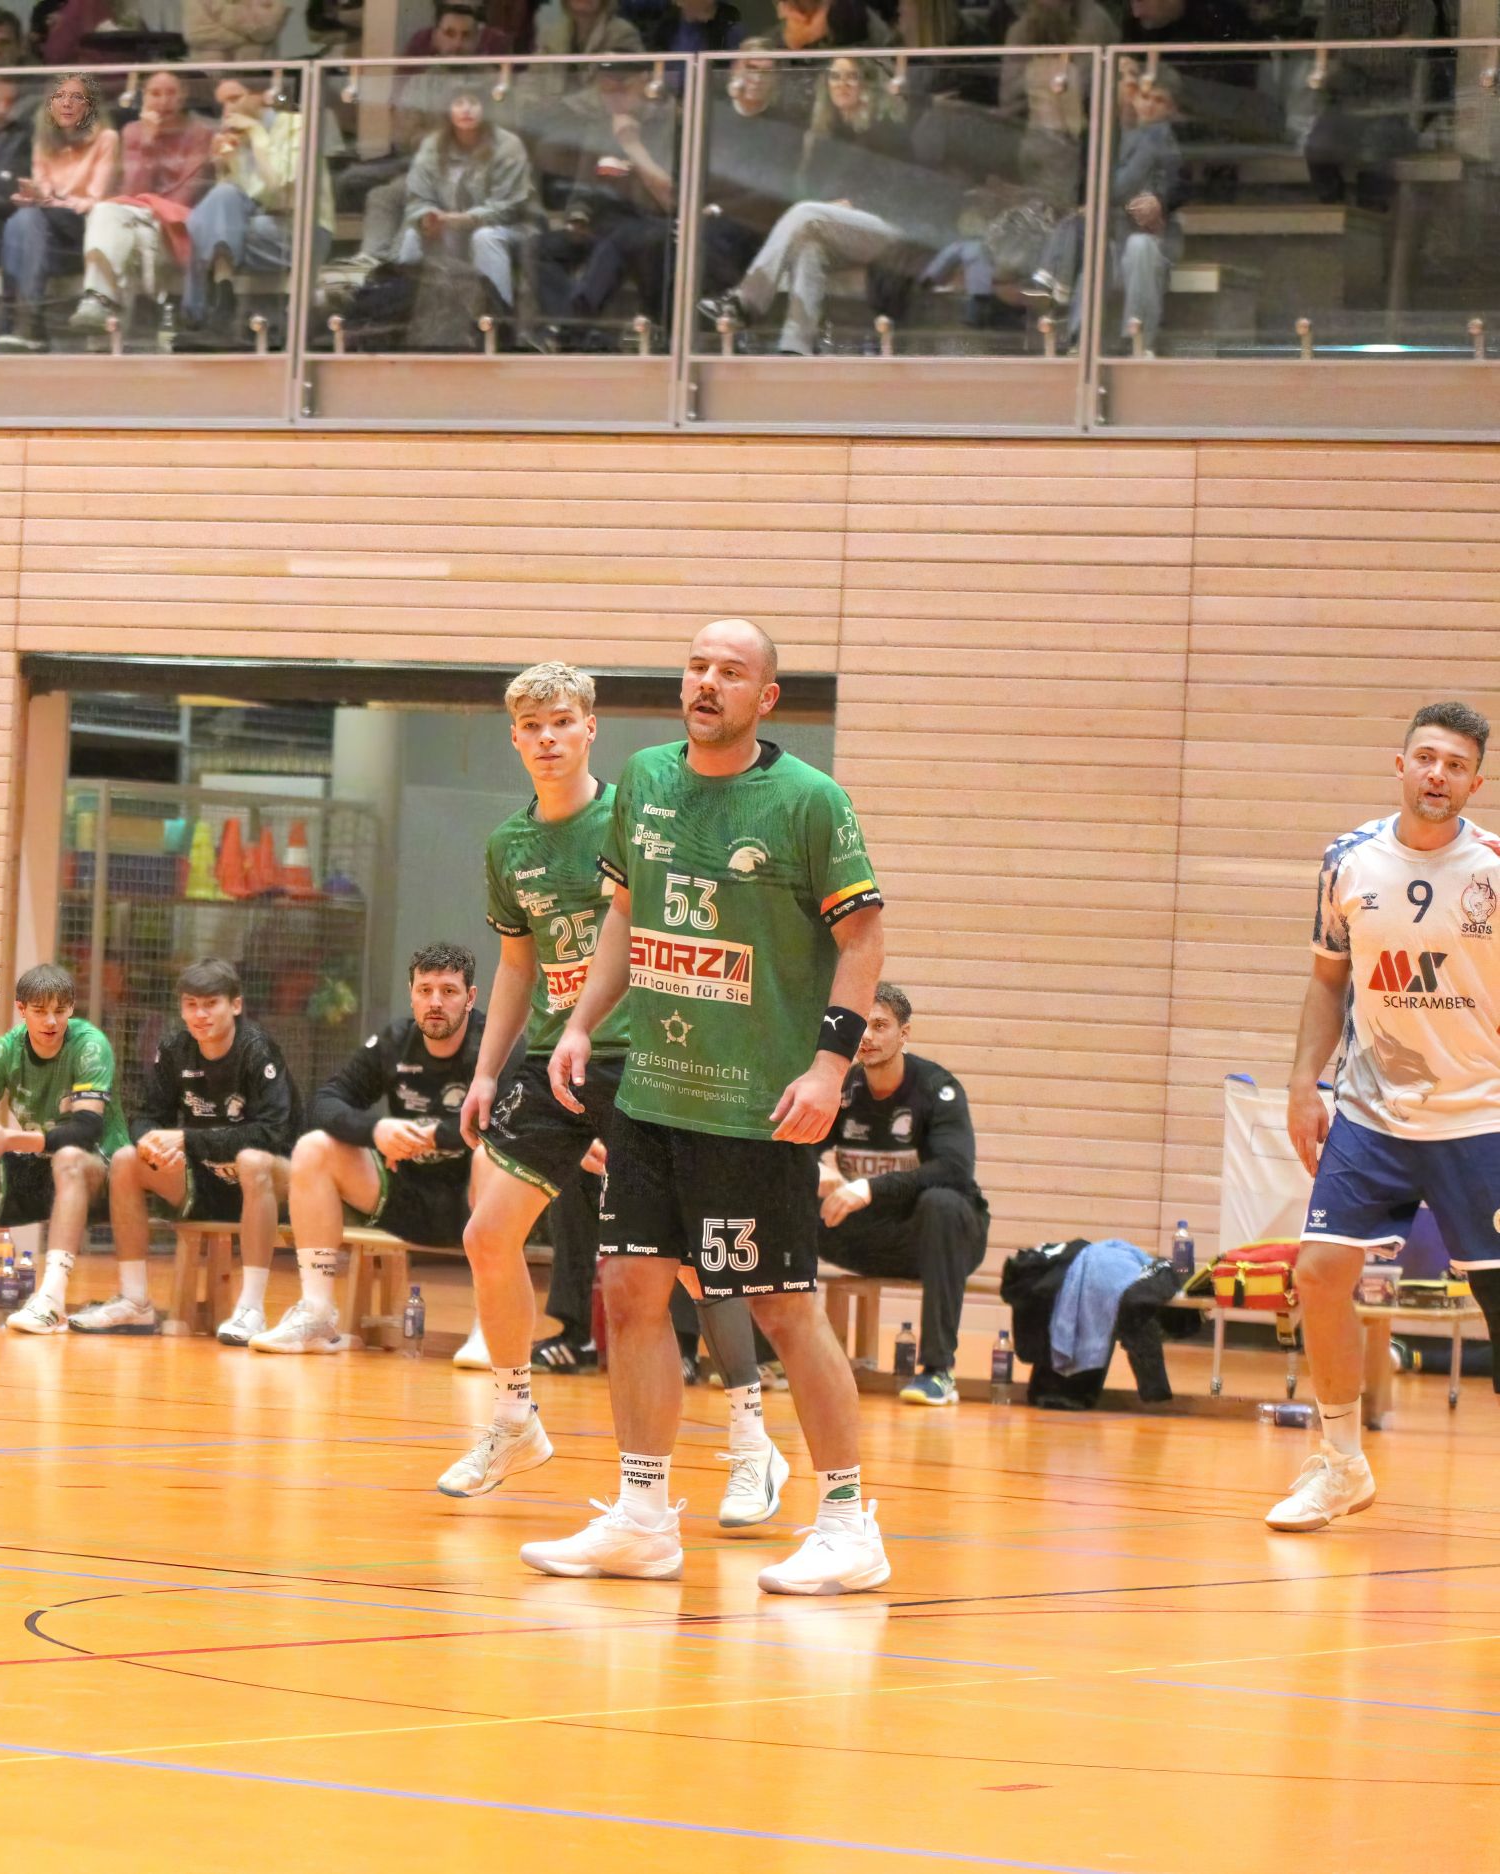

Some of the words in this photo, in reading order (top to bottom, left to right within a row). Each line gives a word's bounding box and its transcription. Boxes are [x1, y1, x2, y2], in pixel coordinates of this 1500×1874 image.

[664, 873, 719, 931] 53
[1407, 880, 1433, 923] 9
[550, 910, 598, 961] 25
[630, 935, 724, 979] STORZ
[697, 984, 720, 999] für
[725, 988, 749, 1003] Sie
[627, 1243, 658, 1254] Kempa
[701, 1218, 759, 1272] 53
[705, 1286, 733, 1297] Kempa
[742, 1285, 774, 1294] Kempa
[783, 1281, 810, 1291] Kempa
